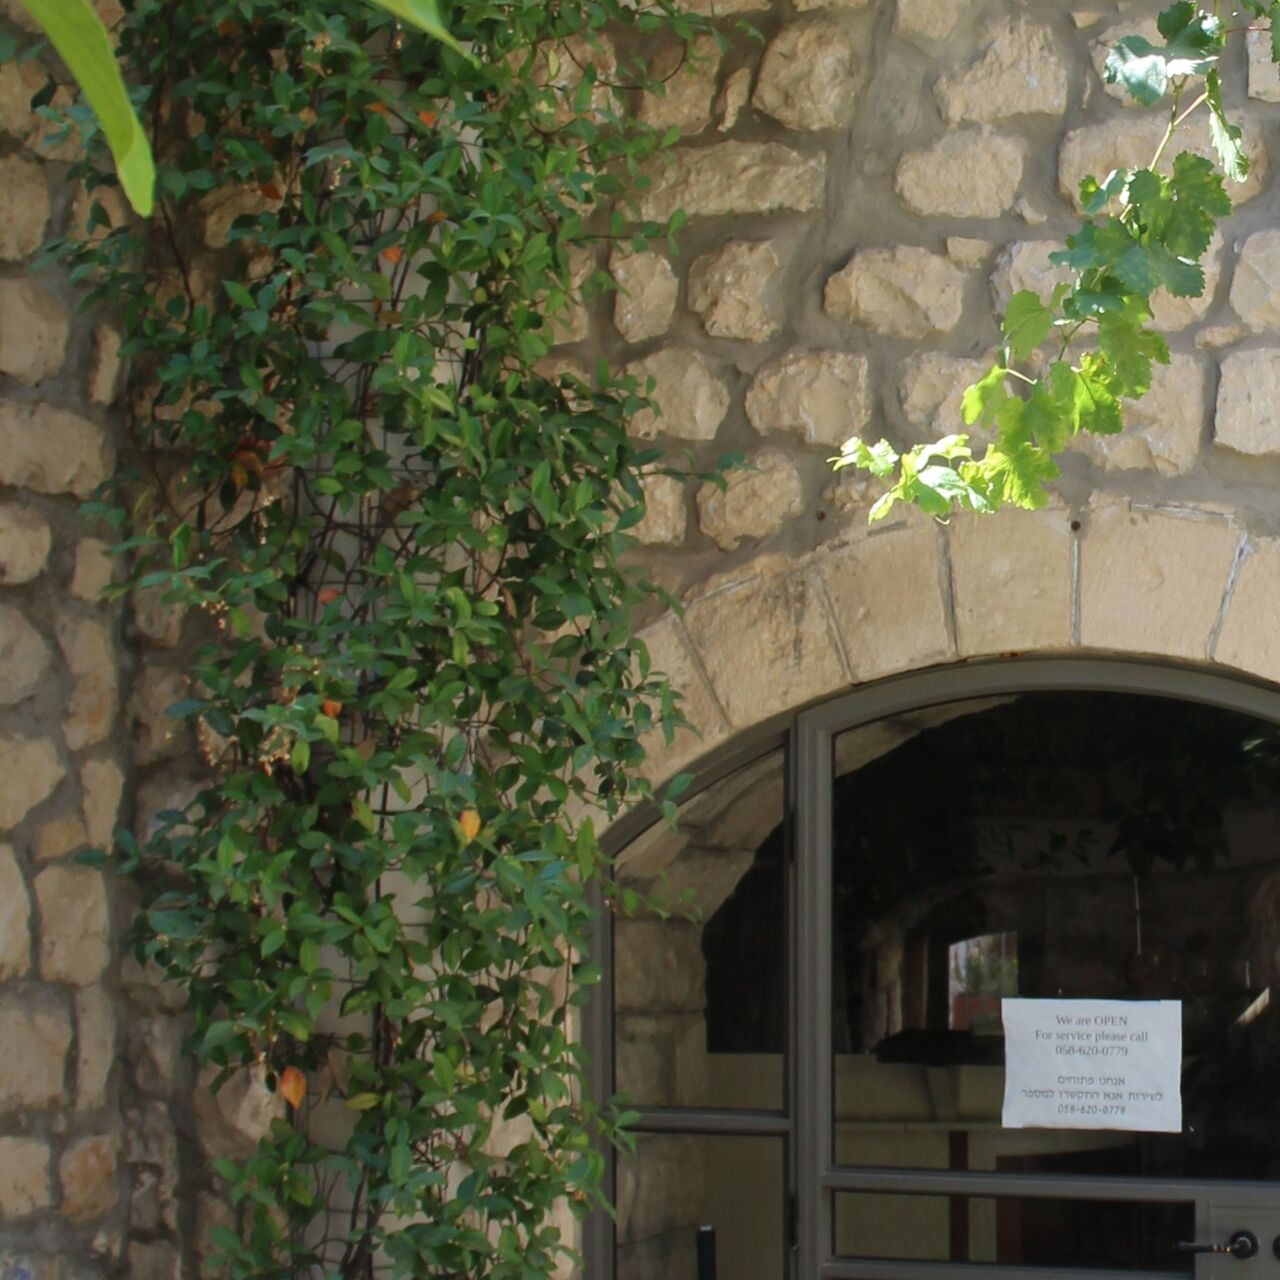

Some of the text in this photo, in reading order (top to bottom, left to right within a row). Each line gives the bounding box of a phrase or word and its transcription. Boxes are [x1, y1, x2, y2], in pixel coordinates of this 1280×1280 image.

[1056, 1015, 1128, 1026] We are OPEN
[1035, 1030, 1148, 1043] For service please call
[1056, 1046, 1128, 1057] 058-620-0779
[1057, 1076, 1126, 1085] אנחנו פתוחים
[1021, 1089, 1164, 1101] לשירות אנא התקשרו למספר
[1057, 1104, 1126, 1114] 058-620-0779
